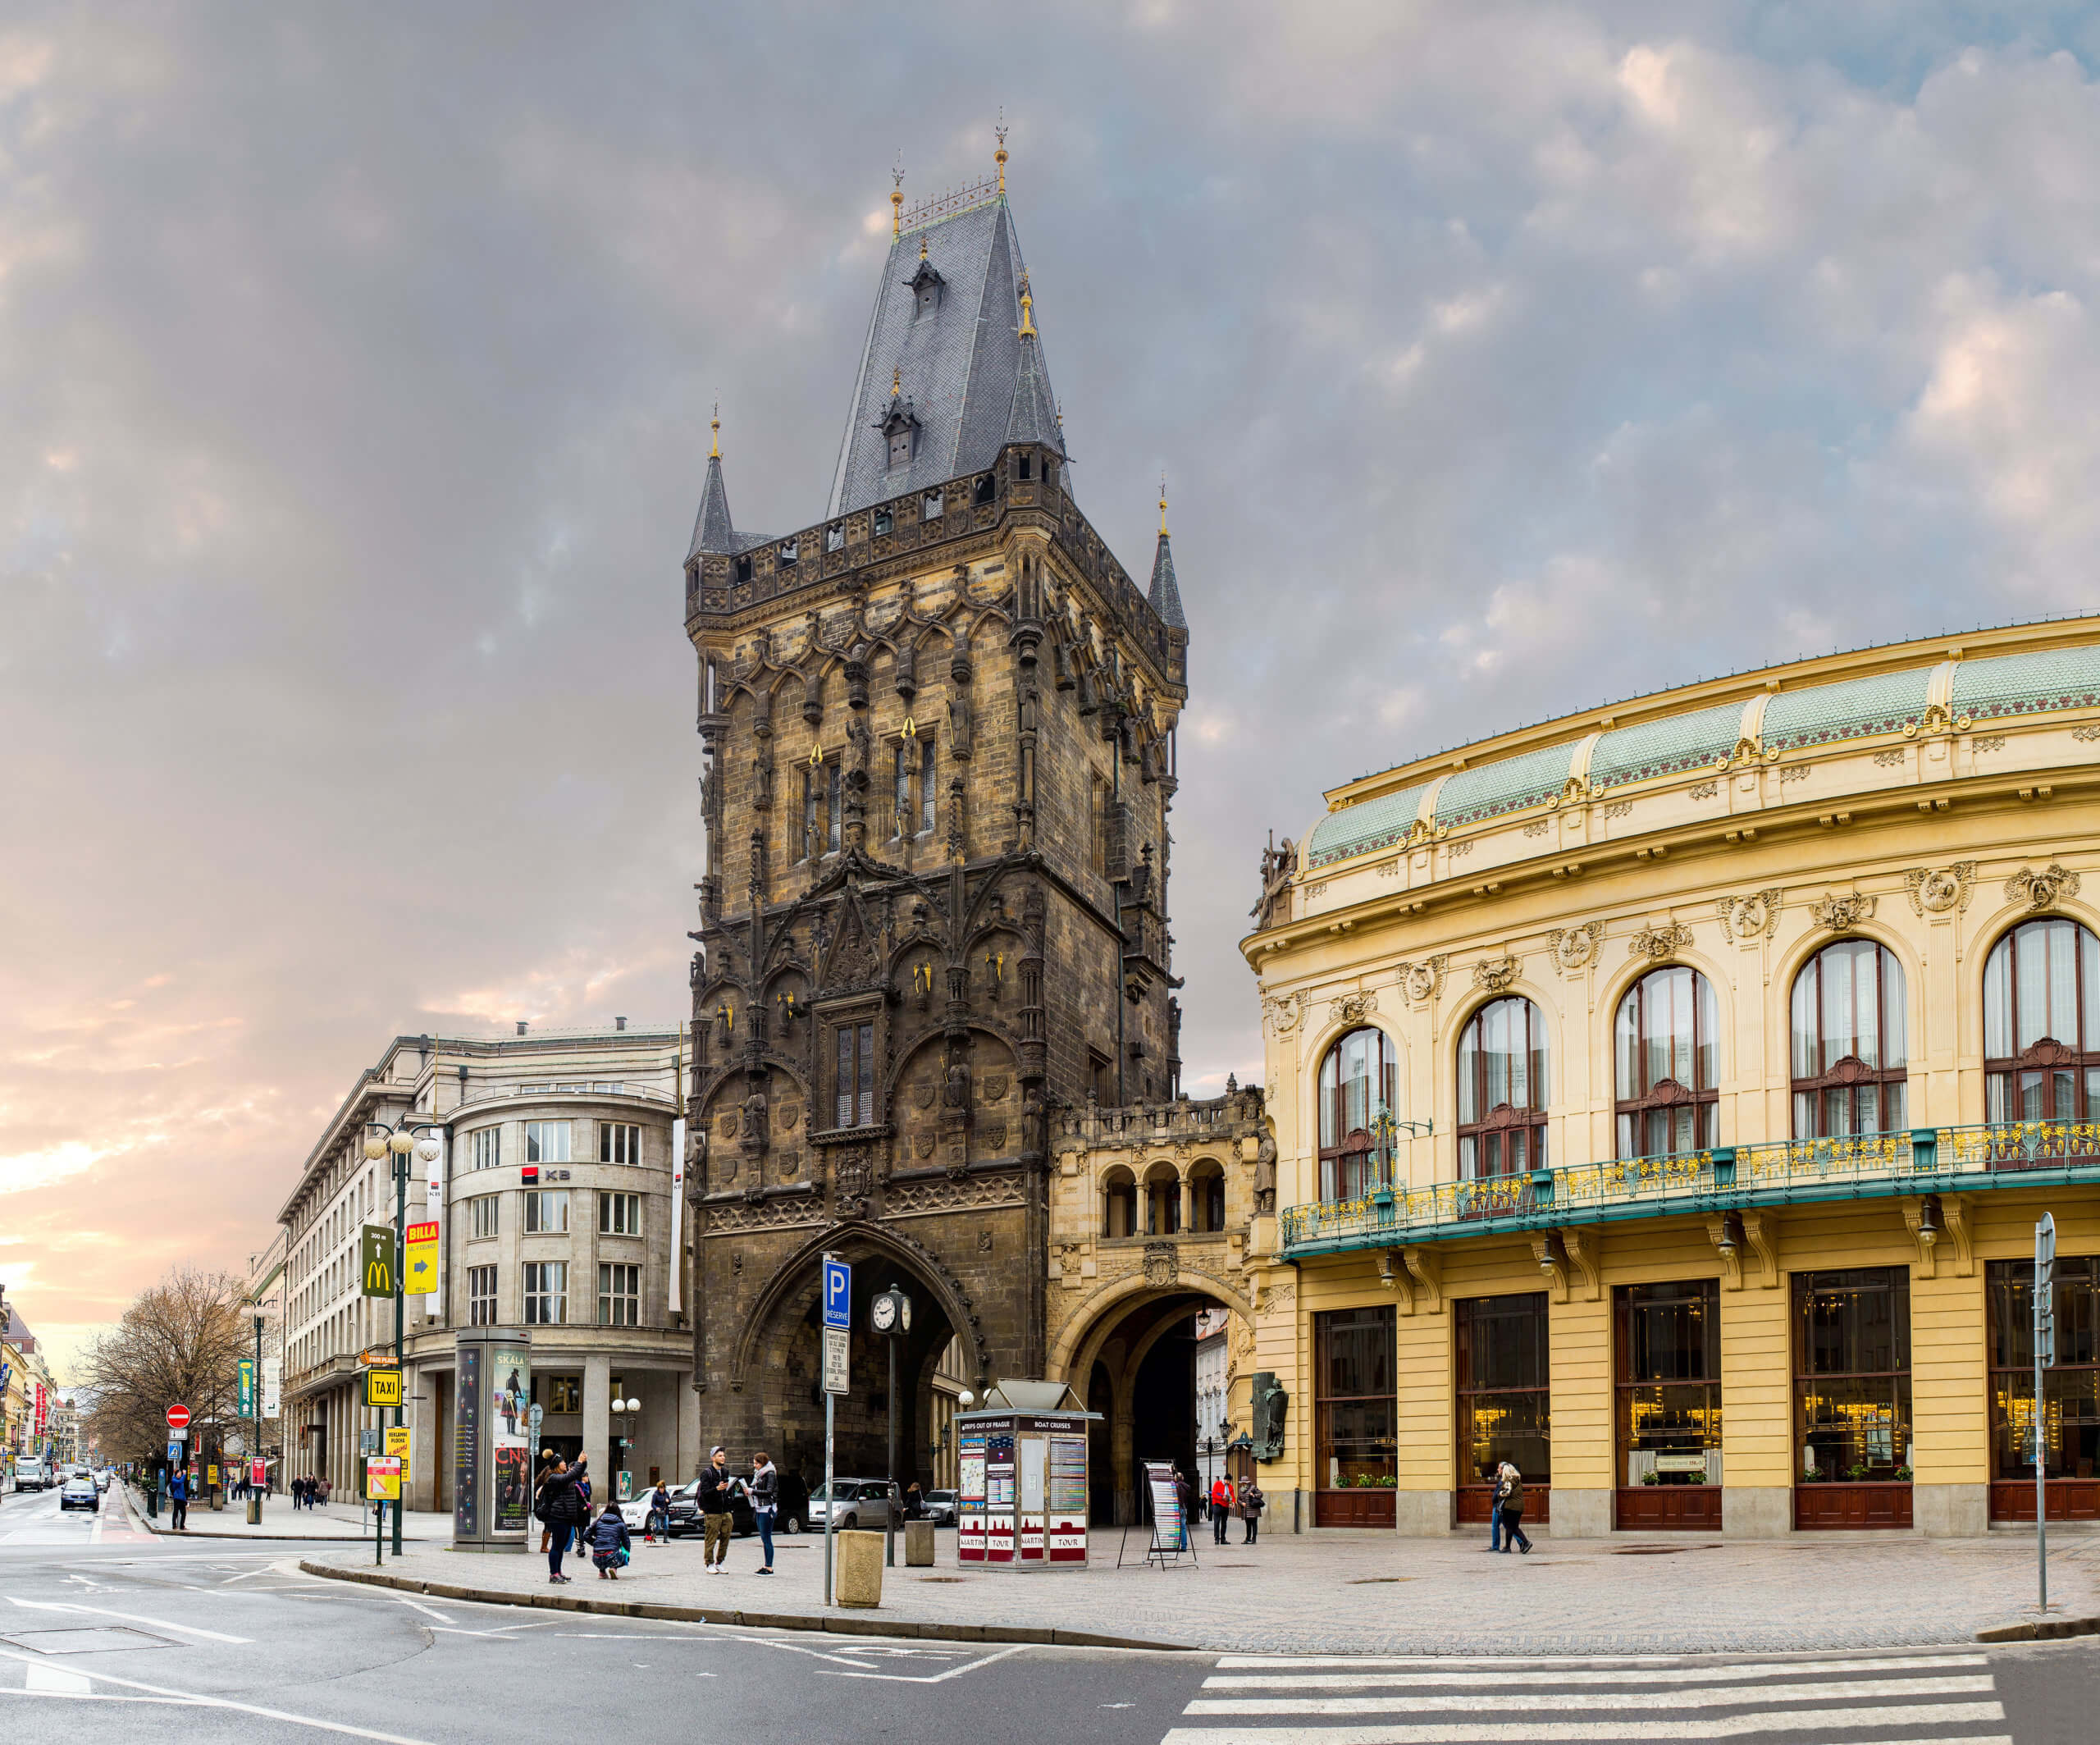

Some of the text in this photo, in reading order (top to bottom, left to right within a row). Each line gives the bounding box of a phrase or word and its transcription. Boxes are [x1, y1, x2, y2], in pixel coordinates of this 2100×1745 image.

[545, 1170, 571, 1181] KB
[409, 1225, 436, 1241] BILLA
[830, 1270, 845, 1306] P
[497, 1355, 524, 1365] SKÁLA
[374, 1381, 395, 1395] TAXI
[961, 1538, 1009, 1547] MARTIN TOUR
[1057, 1538, 1079, 1546] TOUR
